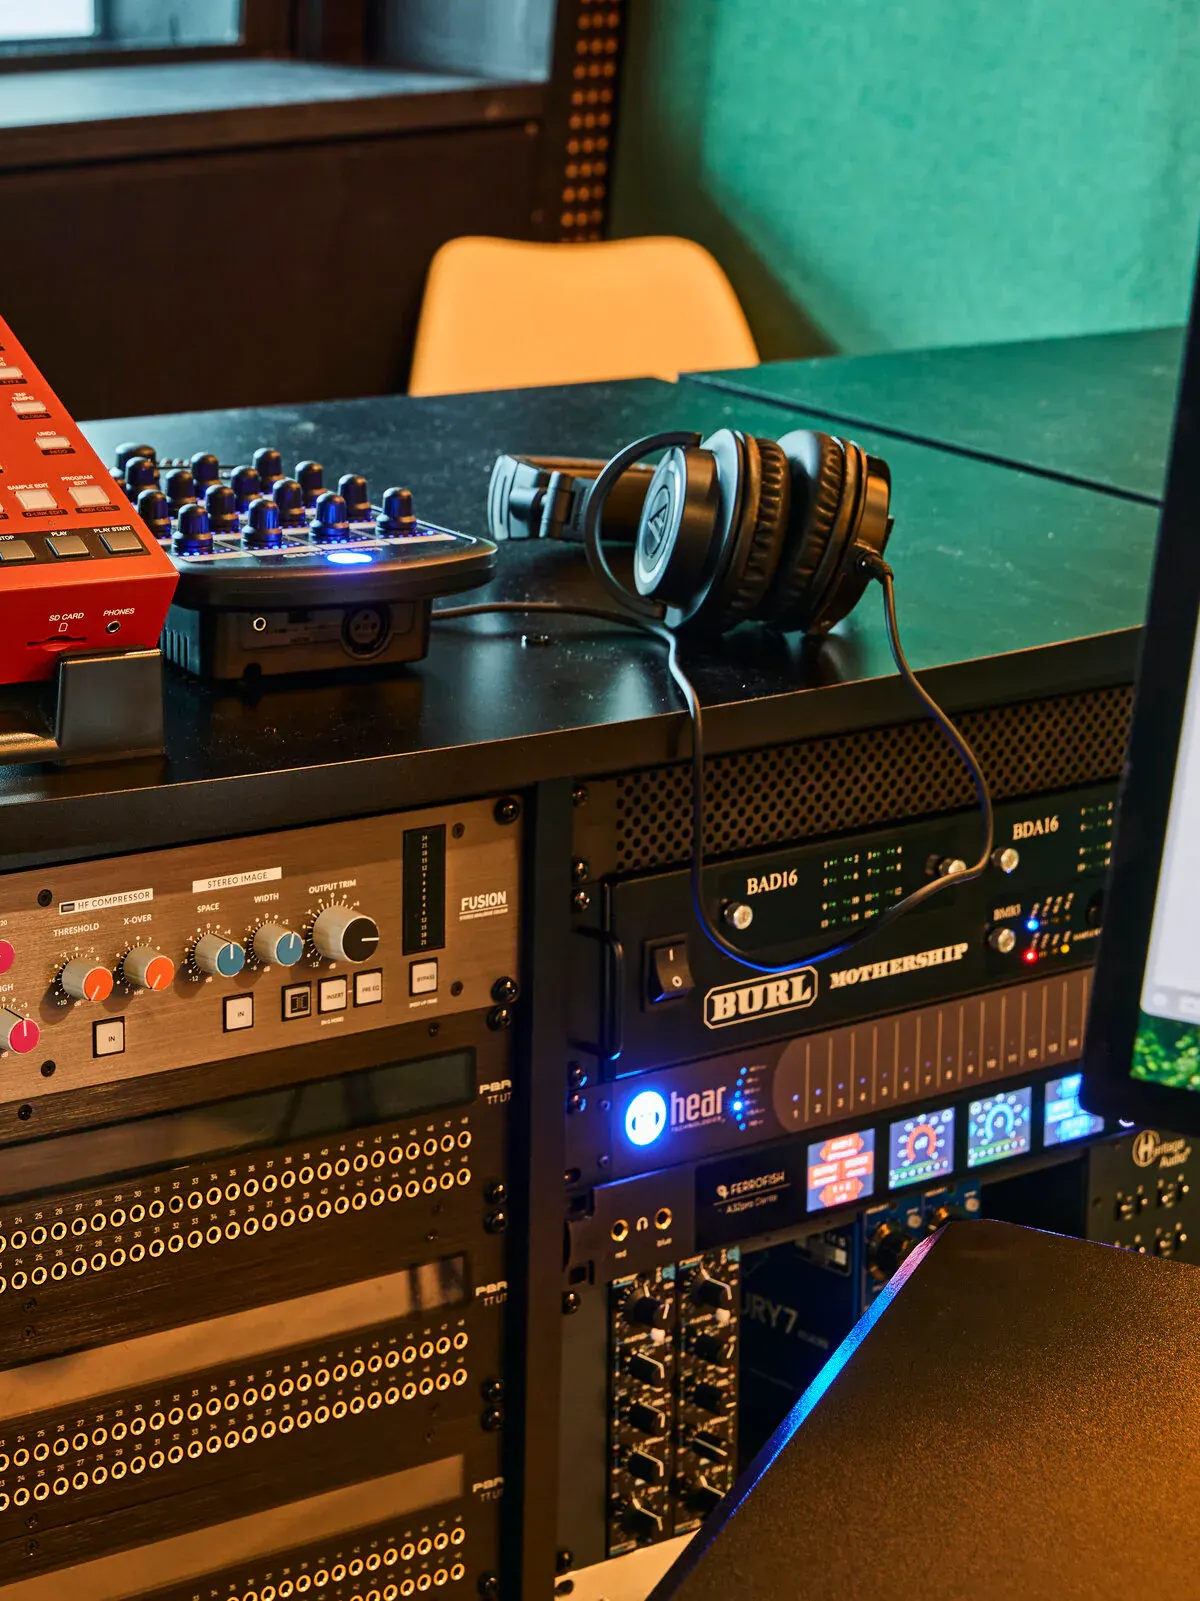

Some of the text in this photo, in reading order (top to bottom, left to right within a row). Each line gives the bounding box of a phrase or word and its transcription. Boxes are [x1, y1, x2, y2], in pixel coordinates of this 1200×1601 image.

[48, 612, 85, 622] SD CARD
[103, 608, 135, 616] PHONES
[1012, 814, 1060, 841] BDA16
[207, 872, 268, 889] STEREO IMAGE
[308, 879, 357, 894] OUTPUT TRIM
[746, 868, 799, 895] BAD16
[77, 891, 151, 910] HF COMPRESSOR
[253, 892, 280, 903] WIDTH
[461, 890, 507, 911] FUSION
[196, 902, 220, 913] SPACE
[123, 914, 153, 925] X-OVER
[53, 922, 100, 937] THRESHOLD
[829, 942, 969, 990] MOTHERSHIP
[326, 991, 345, 1000] INSERT
[710, 973, 813, 1022] BURL
[236, 1010, 245, 1018] IN
[670, 1086, 727, 1126] hear
[730, 1171, 785, 1195] FERROFISH
